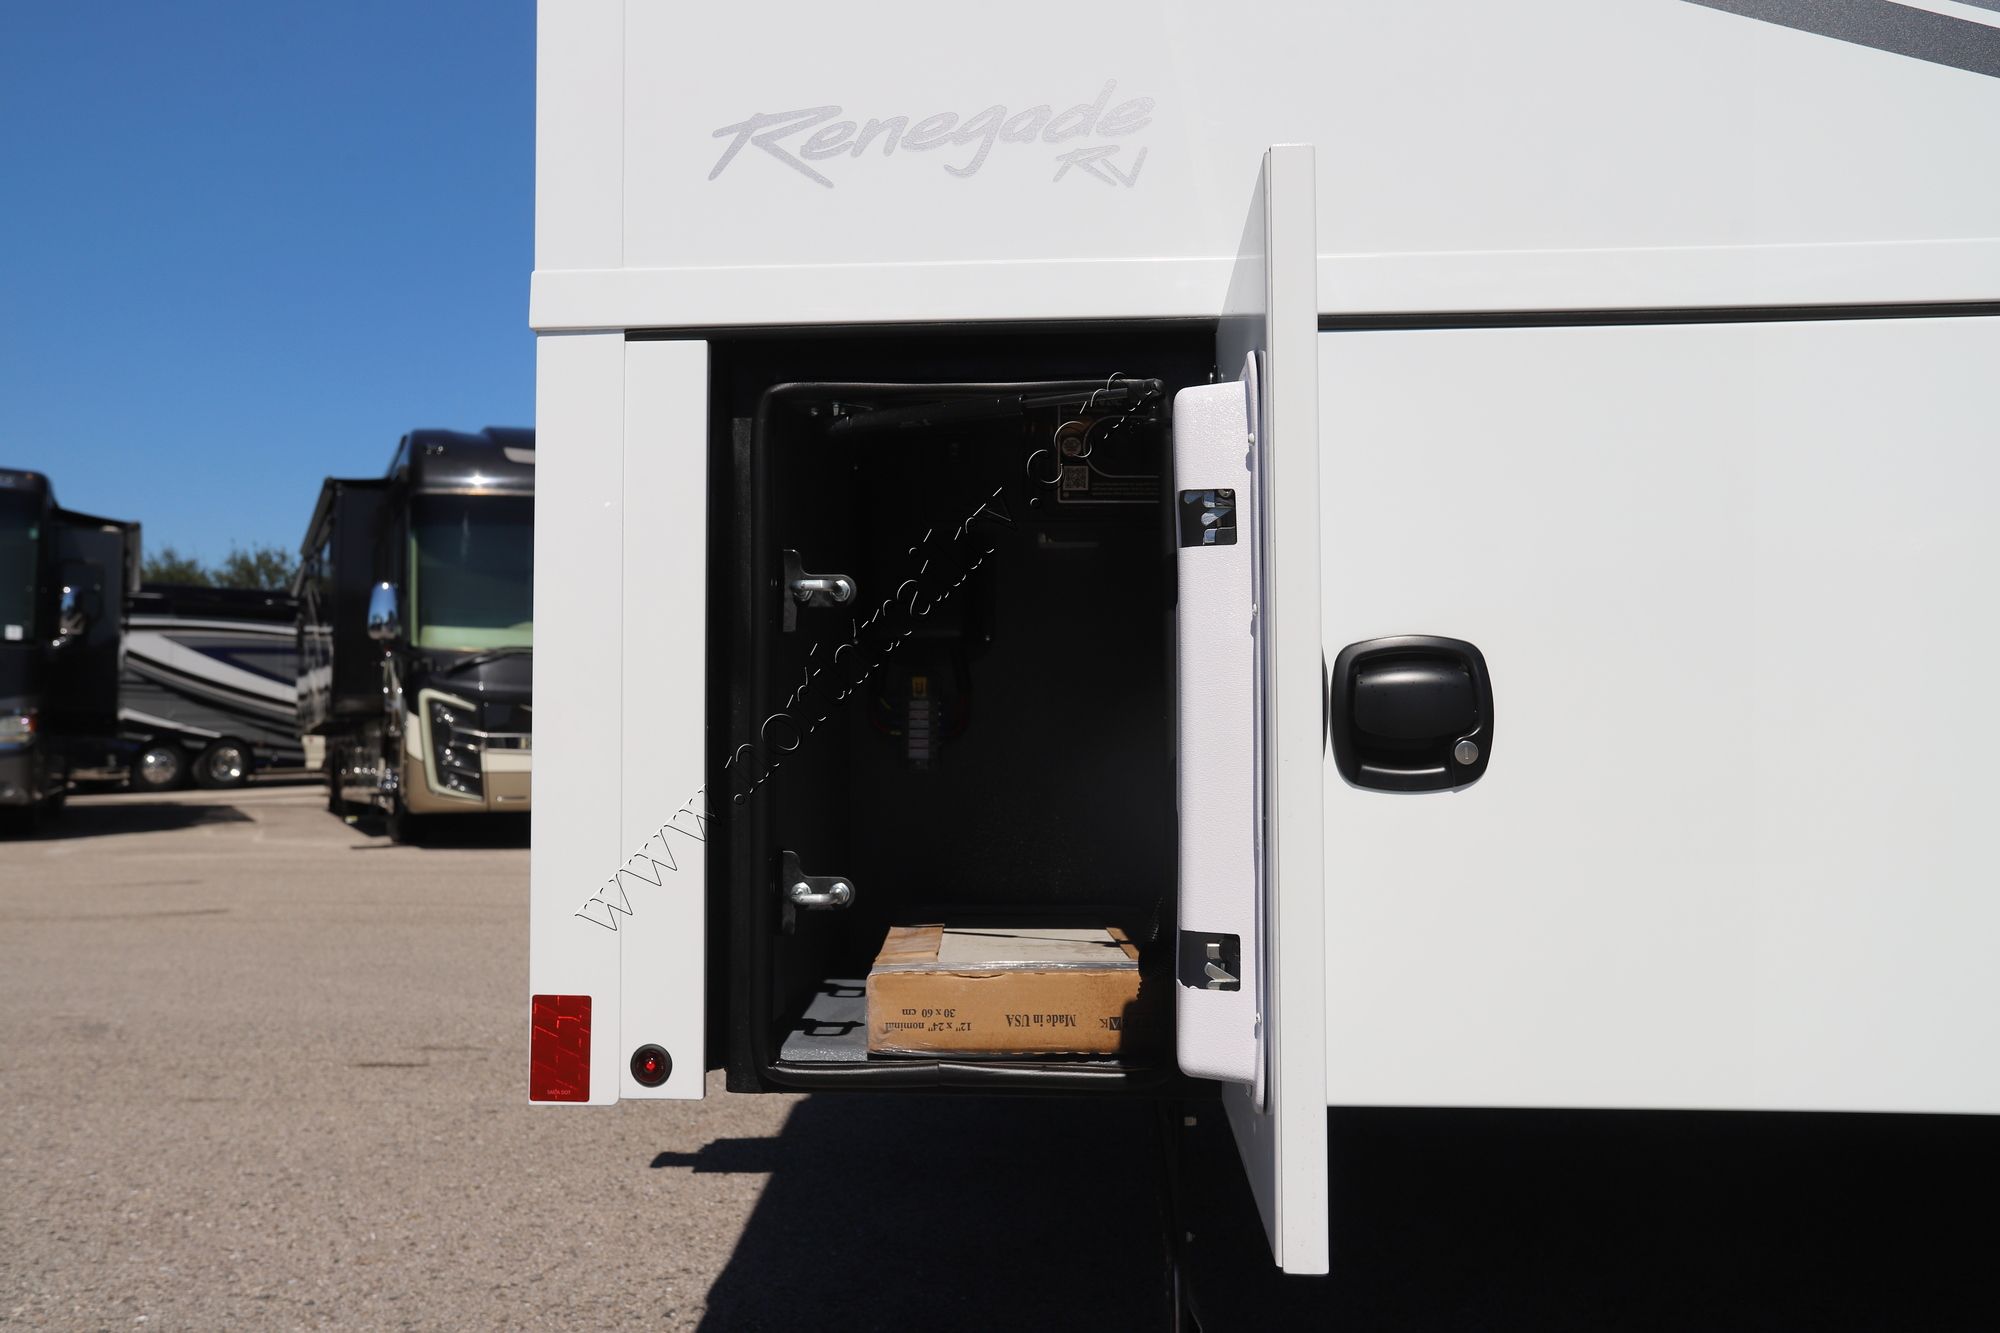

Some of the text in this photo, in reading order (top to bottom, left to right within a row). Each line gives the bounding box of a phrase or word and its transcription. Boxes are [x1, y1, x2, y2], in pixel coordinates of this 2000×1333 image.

[708, 78, 1156, 189] Renegade
[1053, 145, 1148, 188] RV
[902, 1008, 956, 1018] 30 x 60 cm
[1005, 1014, 1077, 1027] Made in USA
